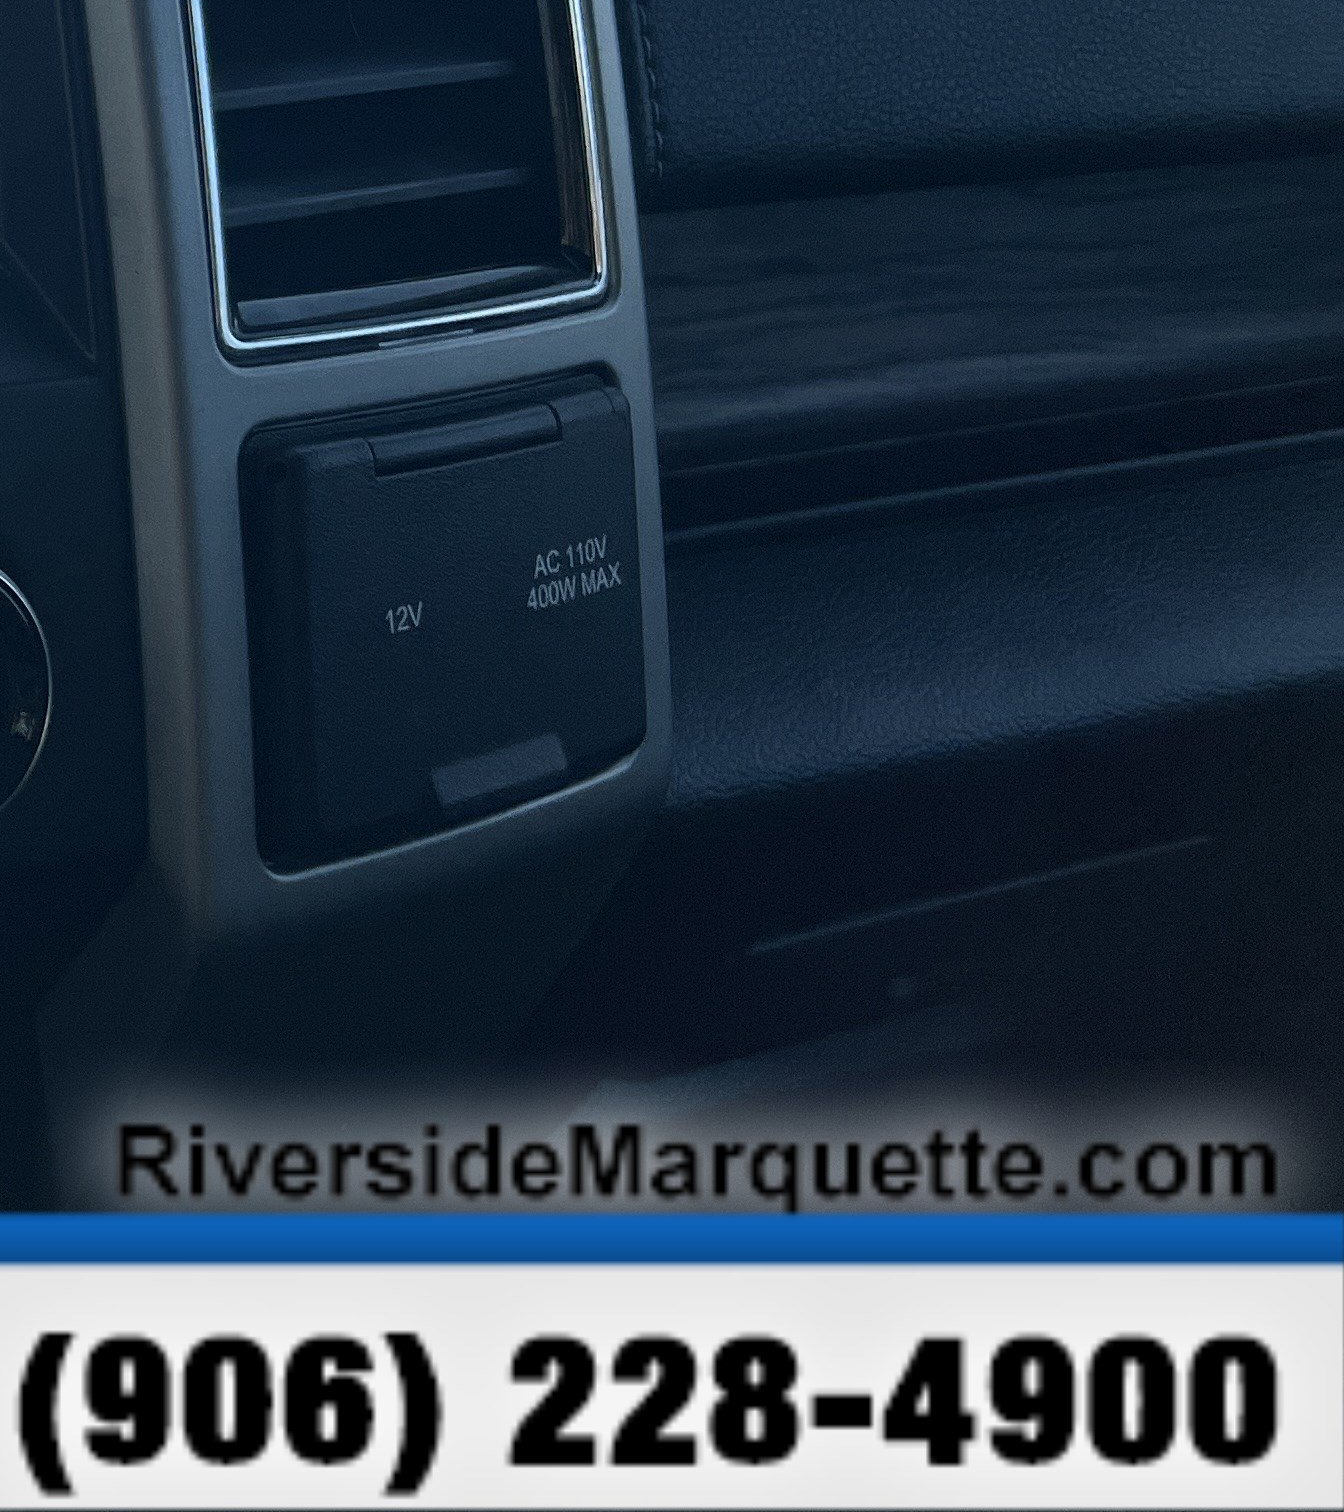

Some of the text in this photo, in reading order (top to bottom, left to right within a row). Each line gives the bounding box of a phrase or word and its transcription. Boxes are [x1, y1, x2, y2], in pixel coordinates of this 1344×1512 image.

[534, 533, 607, 580] AC 110V
[527, 560, 622, 611] 400W MAX
[387, 602, 422, 633] 12V
